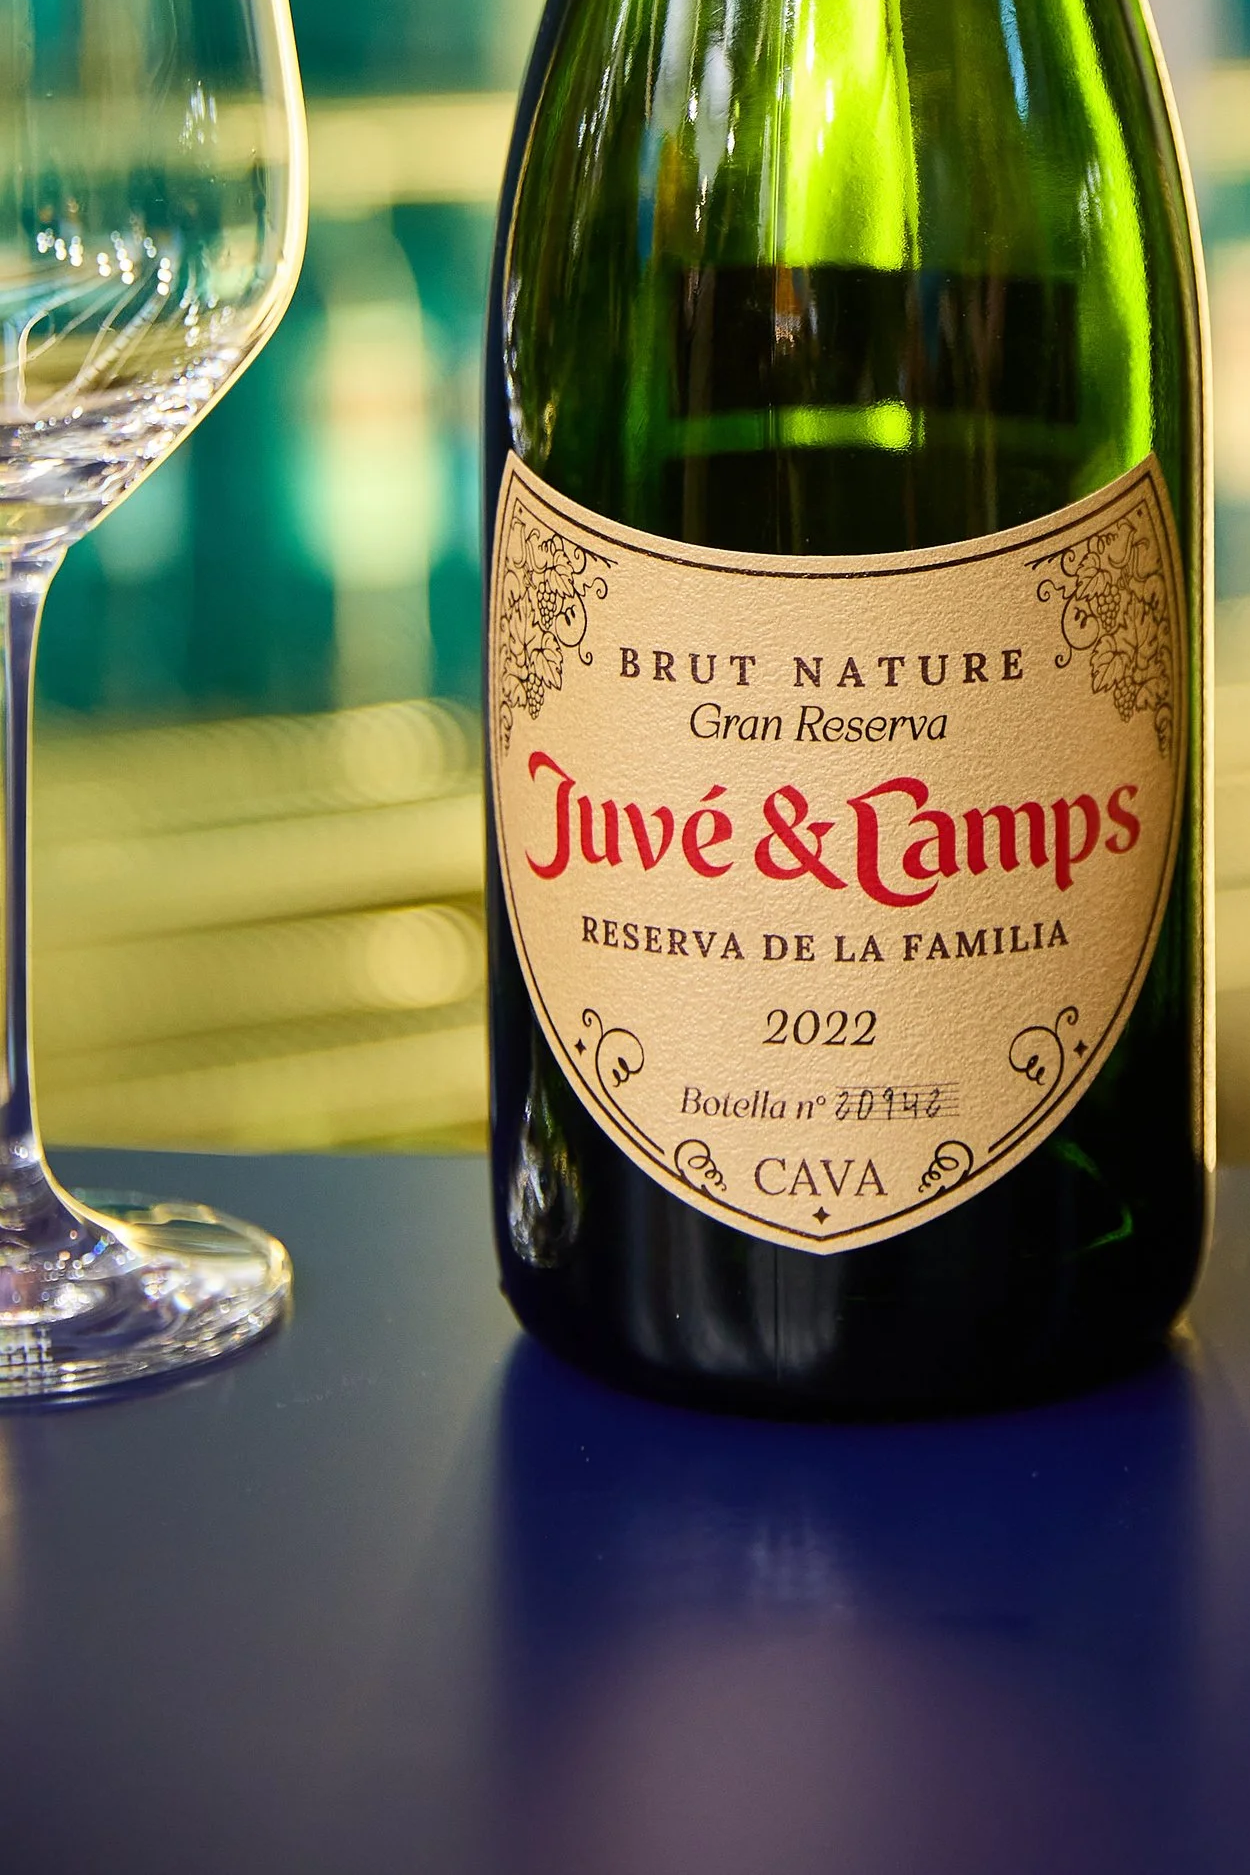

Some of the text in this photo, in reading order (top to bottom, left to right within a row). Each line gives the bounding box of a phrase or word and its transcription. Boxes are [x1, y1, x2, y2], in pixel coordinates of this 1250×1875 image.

[619, 647, 1025, 688] BRUT NATURE
[690, 703, 948, 744] Gran Reserva
[525, 751, 1141, 909] Juvé & Camps
[581, 916, 1070, 963] RESERVA DE LA FAMILIA
[761, 1008, 878, 1047] 2022
[681, 1086, 787, 1121] Botella
[754, 1158, 888, 1198] CAVA
